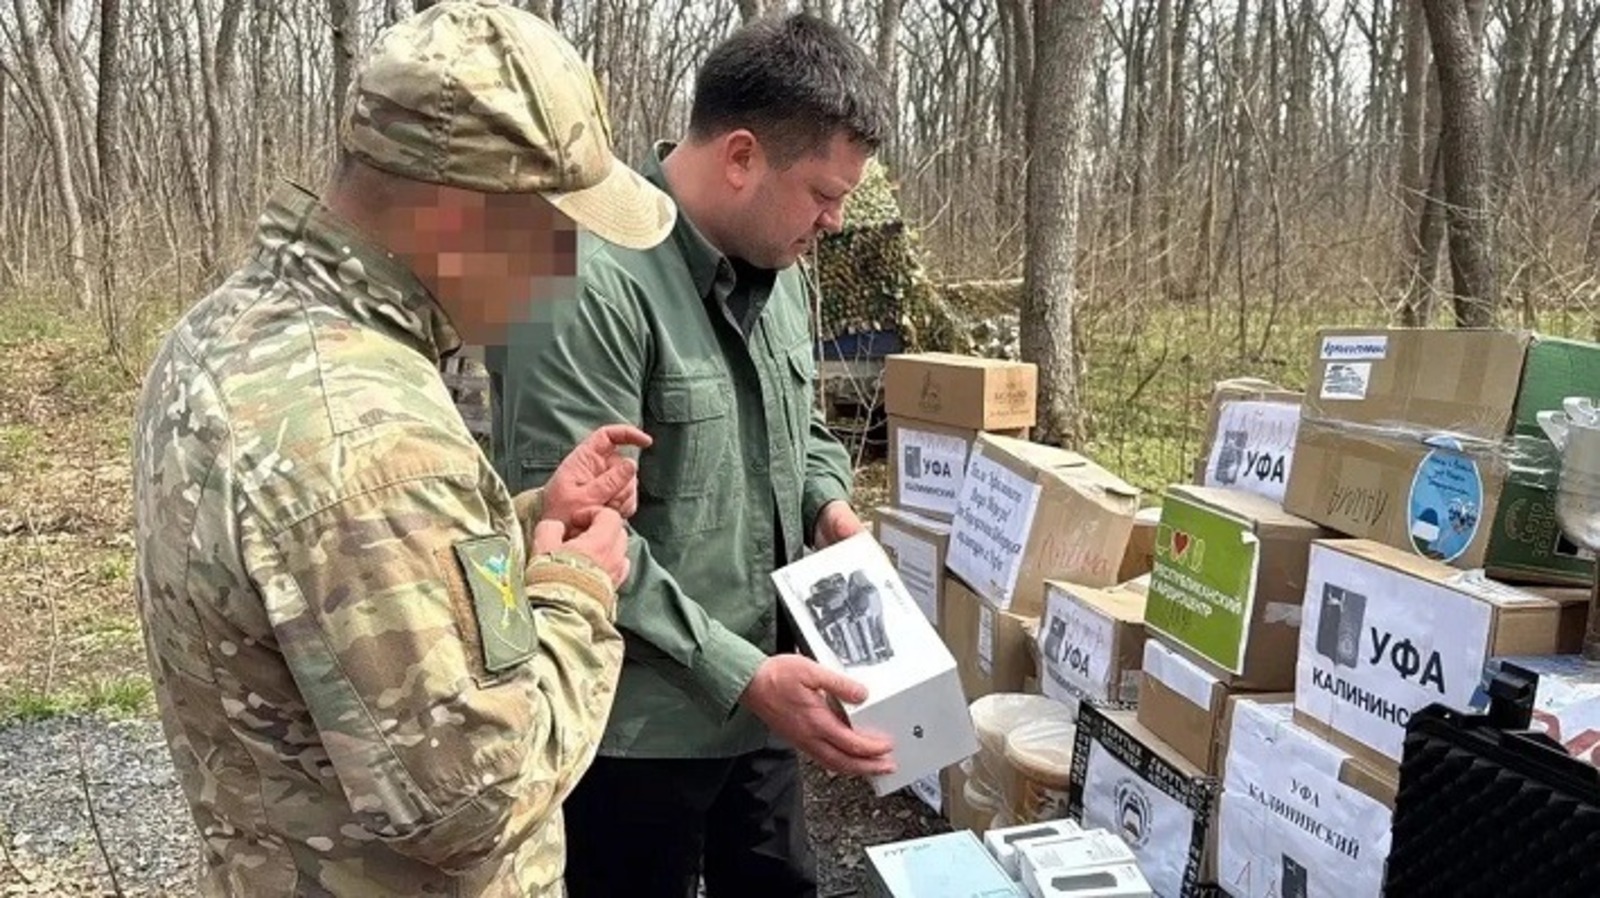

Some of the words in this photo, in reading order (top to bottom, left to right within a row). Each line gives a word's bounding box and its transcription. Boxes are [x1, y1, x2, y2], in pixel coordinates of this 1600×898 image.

[923, 457, 952, 478] УФА
[1243, 450, 1285, 483] УФА
[1062, 641, 1090, 678] УФА
[1369, 626, 1446, 695] УФА
[1312, 666, 1411, 729] КАЛИНИНС
[1290, 778, 1320, 808] УФА
[1248, 782, 1361, 861] КАЛИНИНСКИЙ
